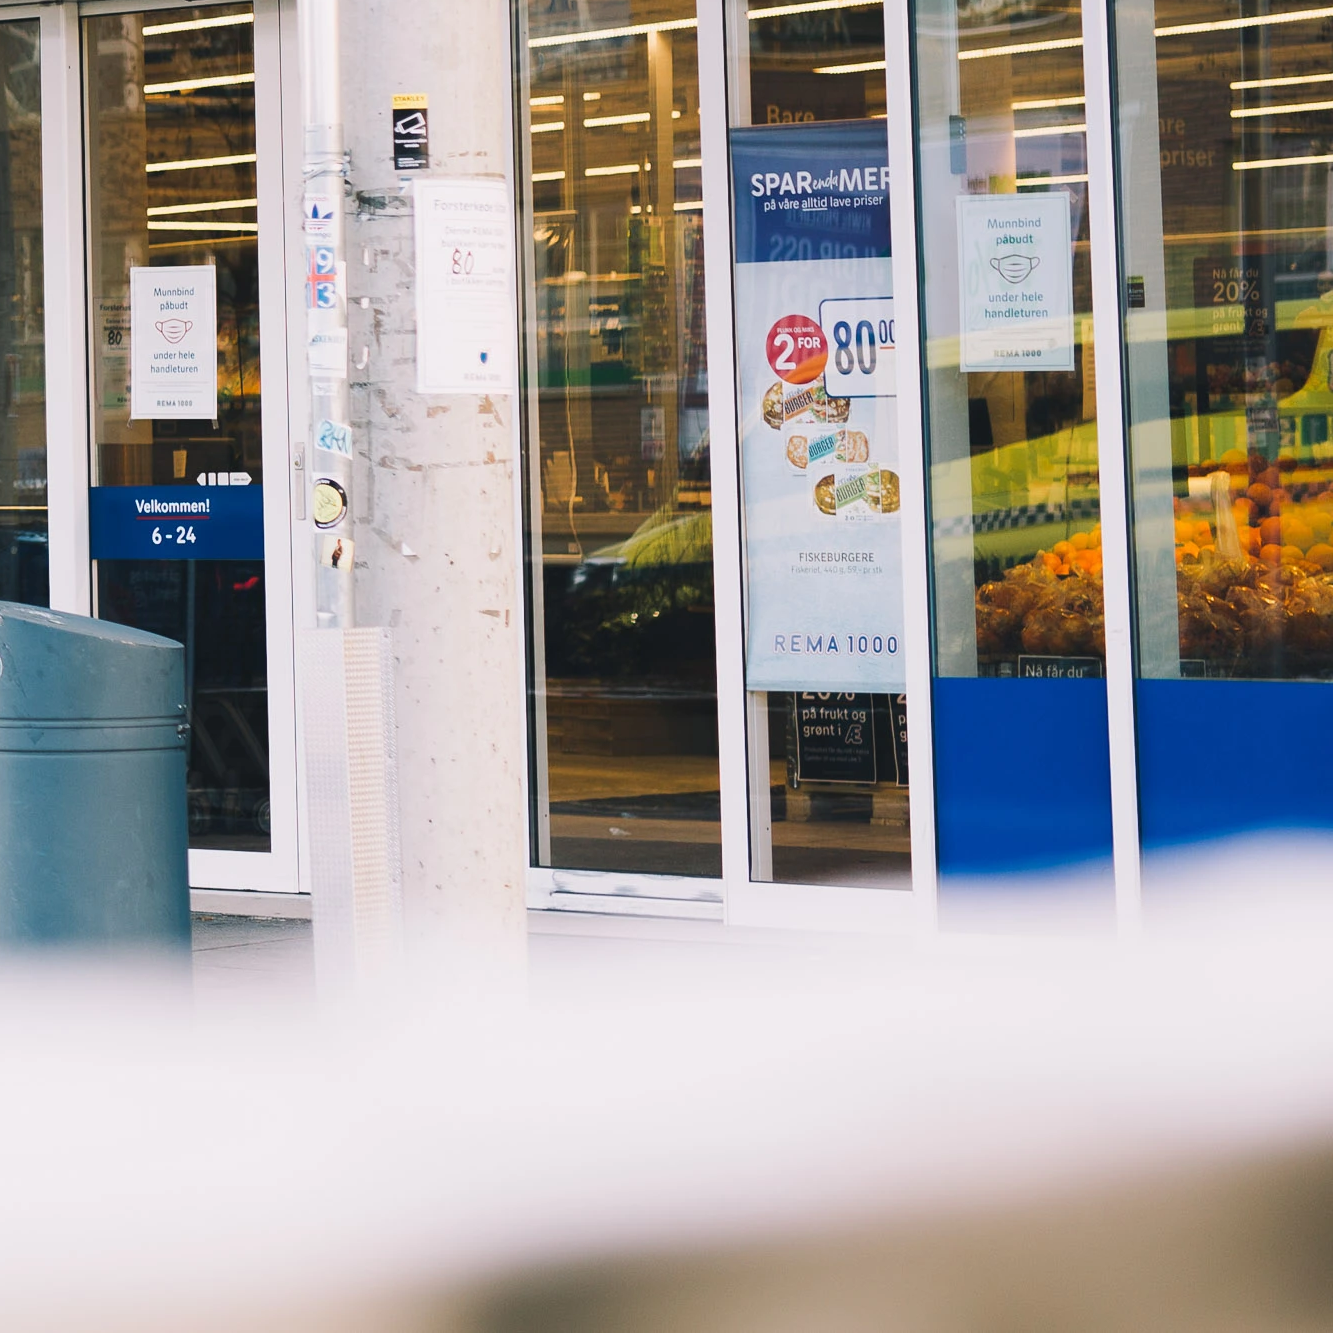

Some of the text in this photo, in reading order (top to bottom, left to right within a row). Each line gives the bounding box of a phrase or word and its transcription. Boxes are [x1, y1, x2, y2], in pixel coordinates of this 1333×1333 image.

[767, 105, 814, 123] Bare
[751, 171, 812, 197] SPAR
[764, 195, 883, 212] på våre alltid lave priser
[987, 218, 1041, 229] Munnbind
[996, 234, 1033, 246] påbudt
[452, 248, 474, 275] 80
[1246, 268, 1259, 278] du
[154, 288, 194, 297] Munnbind
[989, 291, 1043, 302] under hele
[1213, 281, 1260, 303] 20%
[160, 302, 188, 311] påbudt
[985, 308, 1048, 318] handleturen
[108, 332, 122, 345] 80
[179, 351, 195, 359] hele
[774, 334, 821, 370] 2 FOR
[834, 320, 876, 375] 80
[151, 365, 198, 373] handleturen
[785, 391, 814, 414] BURGER
[809, 437, 834, 457] BURGER
[836, 478, 865, 502] BURGER
[135, 498, 210, 513] Velkommen!
[799, 552, 875, 562] FISKEBURGERE
[774, 634, 898, 654] REMA 1000
[803, 706, 866, 722] på frukt og
[803, 724, 862, 744] grønt i Æ
